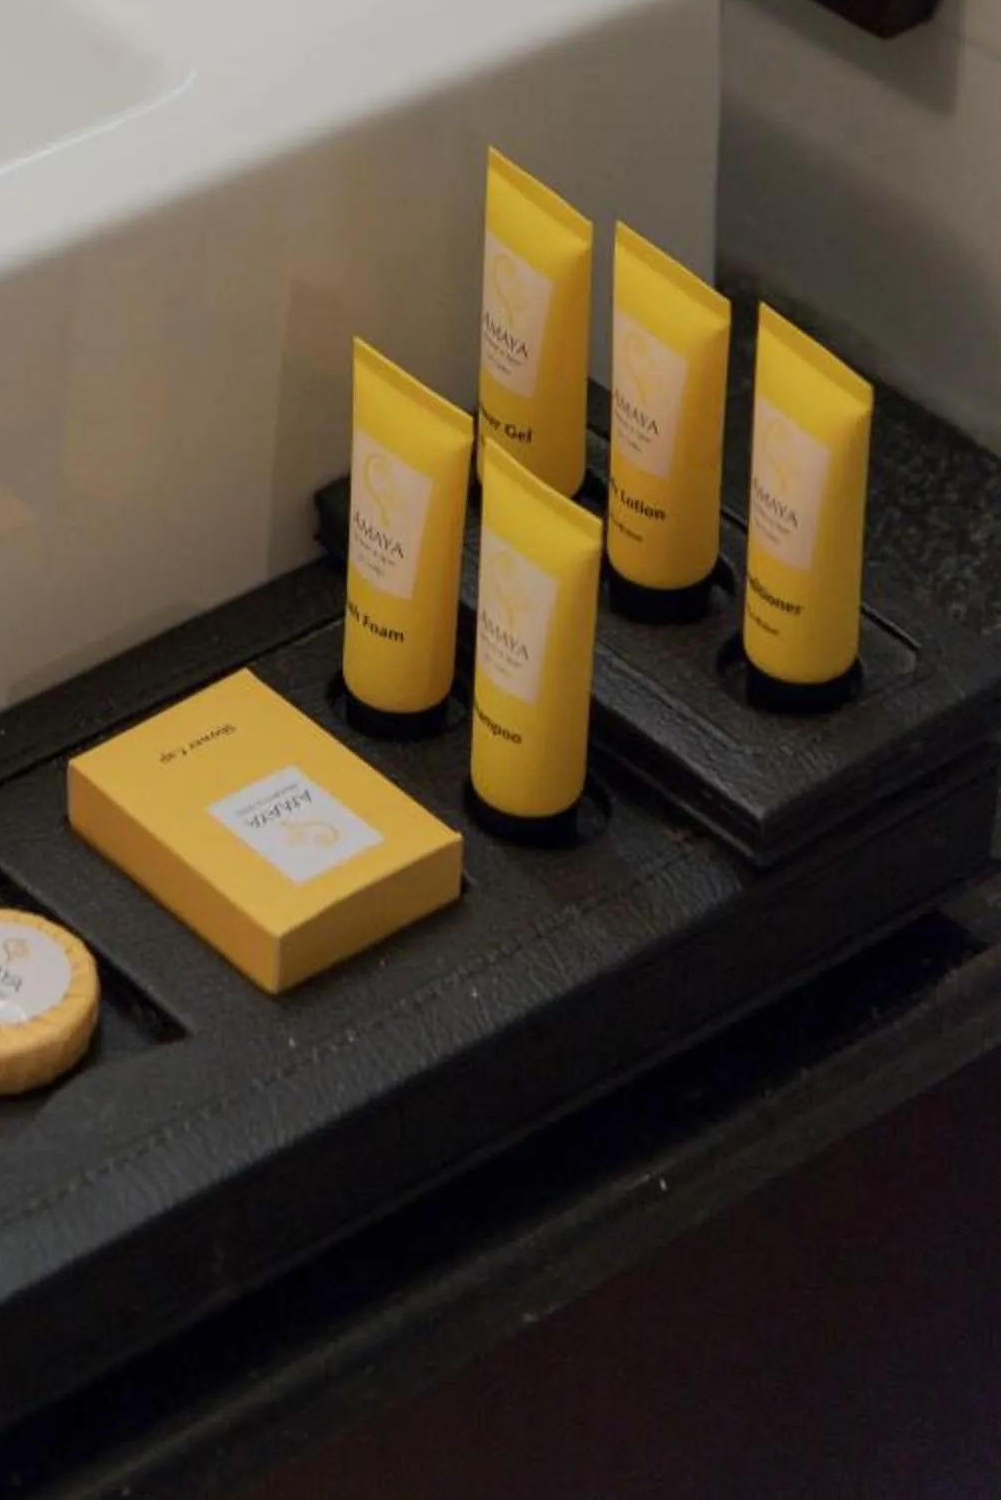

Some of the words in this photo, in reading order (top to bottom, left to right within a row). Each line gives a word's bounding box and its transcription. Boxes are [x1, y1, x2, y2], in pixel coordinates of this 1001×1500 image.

[483, 312, 530, 360] AMAYA
[612, 387, 660, 437] AMAYA
[504, 423, 533, 444] Gel
[619, 488, 667, 521] Lotion
[353, 510, 405, 560] AMAYA
[362, 614, 405, 643] Foam
[480, 610, 530, 662] AMAYA
[189, 723, 237, 751] Shower
[247, 788, 313, 829] AMAYA
